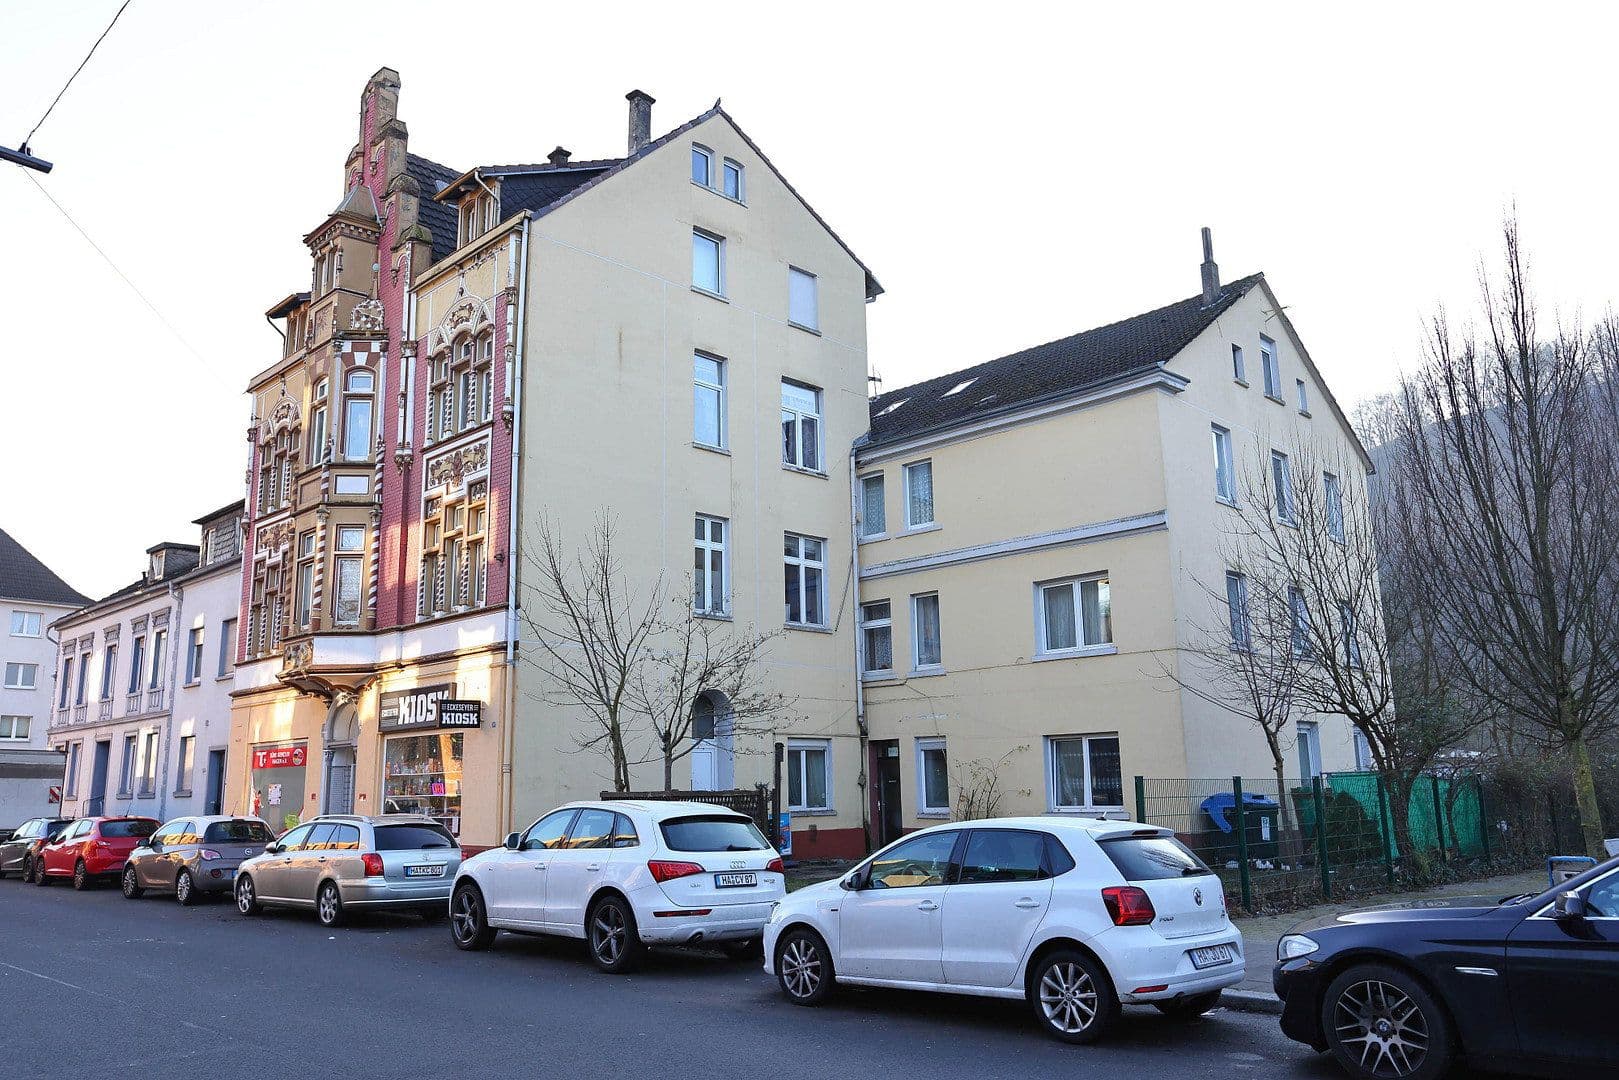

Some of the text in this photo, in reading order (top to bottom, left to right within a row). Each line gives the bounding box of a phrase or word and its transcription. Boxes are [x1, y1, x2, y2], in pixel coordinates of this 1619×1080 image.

[447, 703, 474, 711] ECKESEYER
[442, 712, 478, 725] KIOSK
[721, 875, 731, 885] HA
[744, 874, 753, 883] 87
